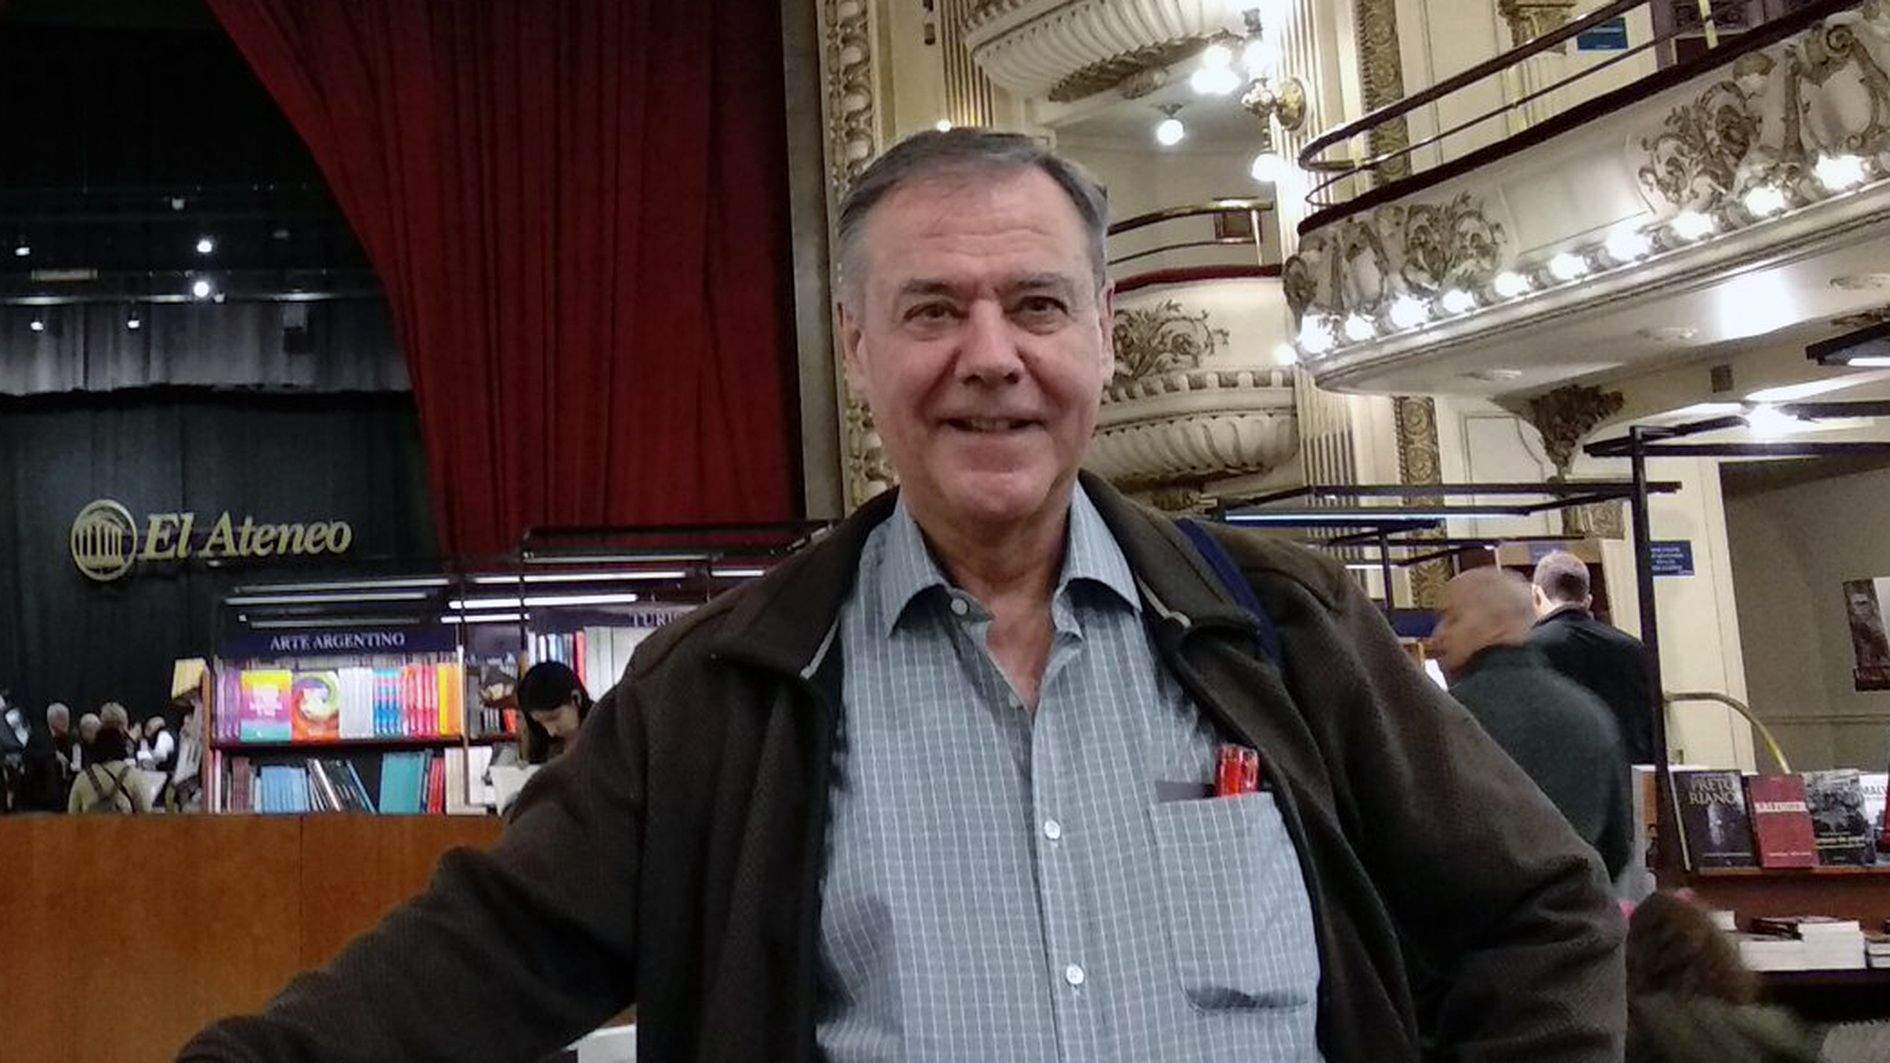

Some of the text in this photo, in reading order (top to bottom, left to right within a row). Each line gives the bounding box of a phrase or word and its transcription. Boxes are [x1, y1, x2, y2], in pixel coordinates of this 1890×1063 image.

[138, 510, 352, 560] El Ateneo
[270, 631, 406, 651] ARTE ARGENTINO
